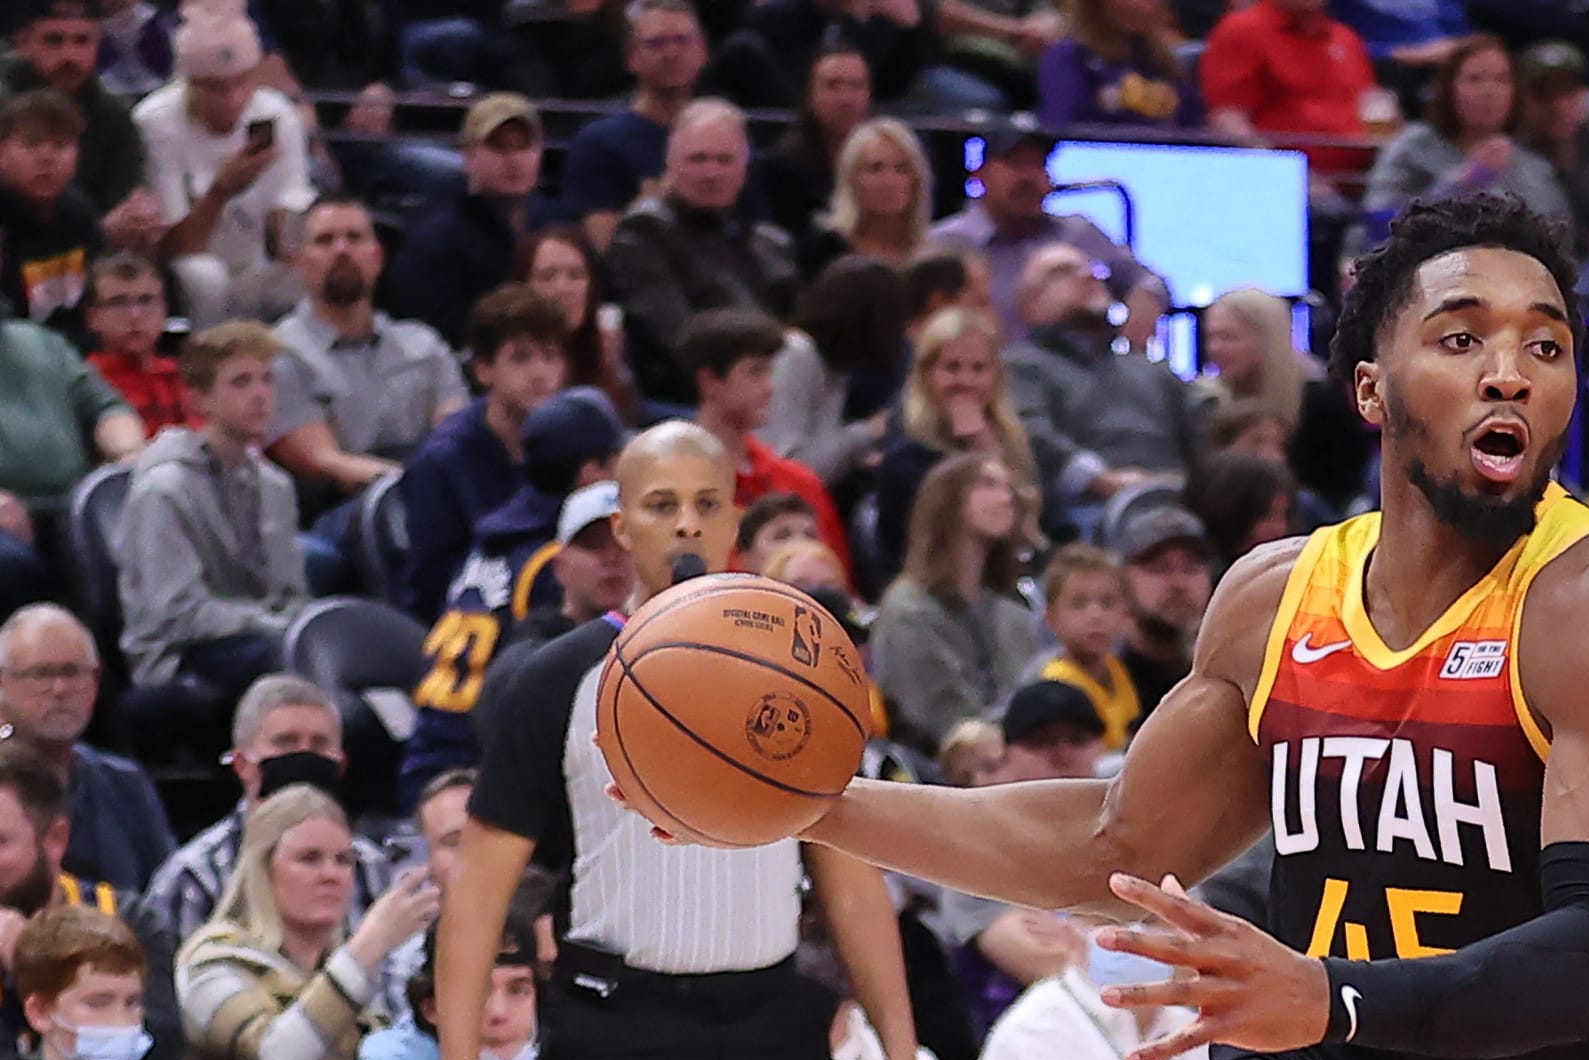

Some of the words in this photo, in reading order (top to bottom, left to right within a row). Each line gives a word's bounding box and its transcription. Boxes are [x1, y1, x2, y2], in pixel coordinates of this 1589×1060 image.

[1446, 646, 1471, 674] 5
[1466, 661, 1500, 674] FIGHT
[1271, 736, 1513, 873] UTAH
